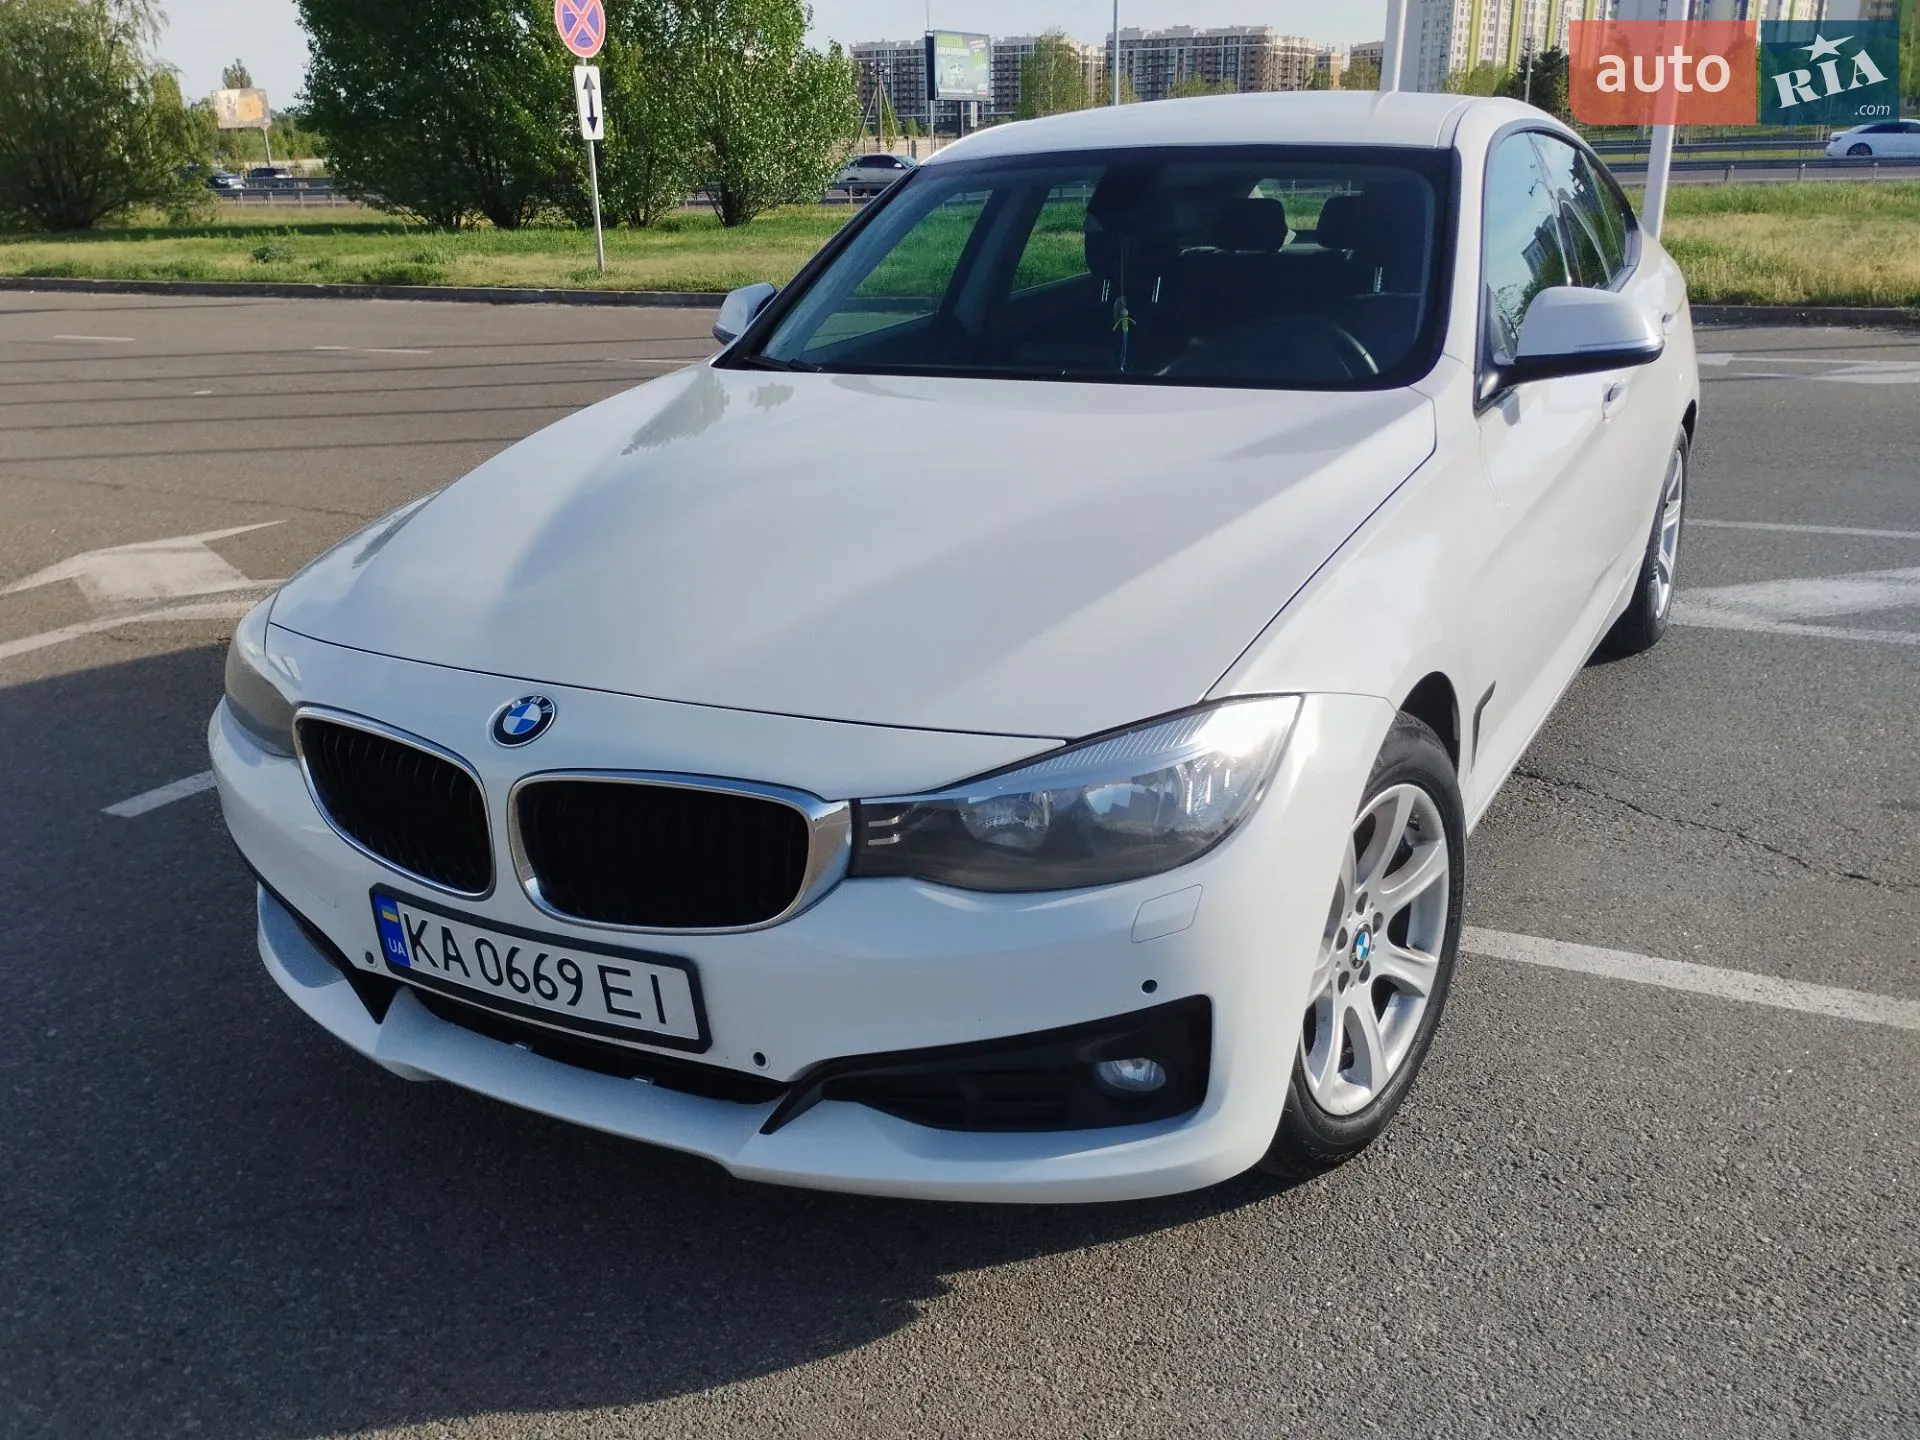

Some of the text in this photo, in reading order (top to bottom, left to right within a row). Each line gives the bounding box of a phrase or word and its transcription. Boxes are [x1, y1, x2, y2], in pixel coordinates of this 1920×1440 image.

[387, 937, 408, 957] UA
[403, 912, 667, 1025] KA 0669 EI
